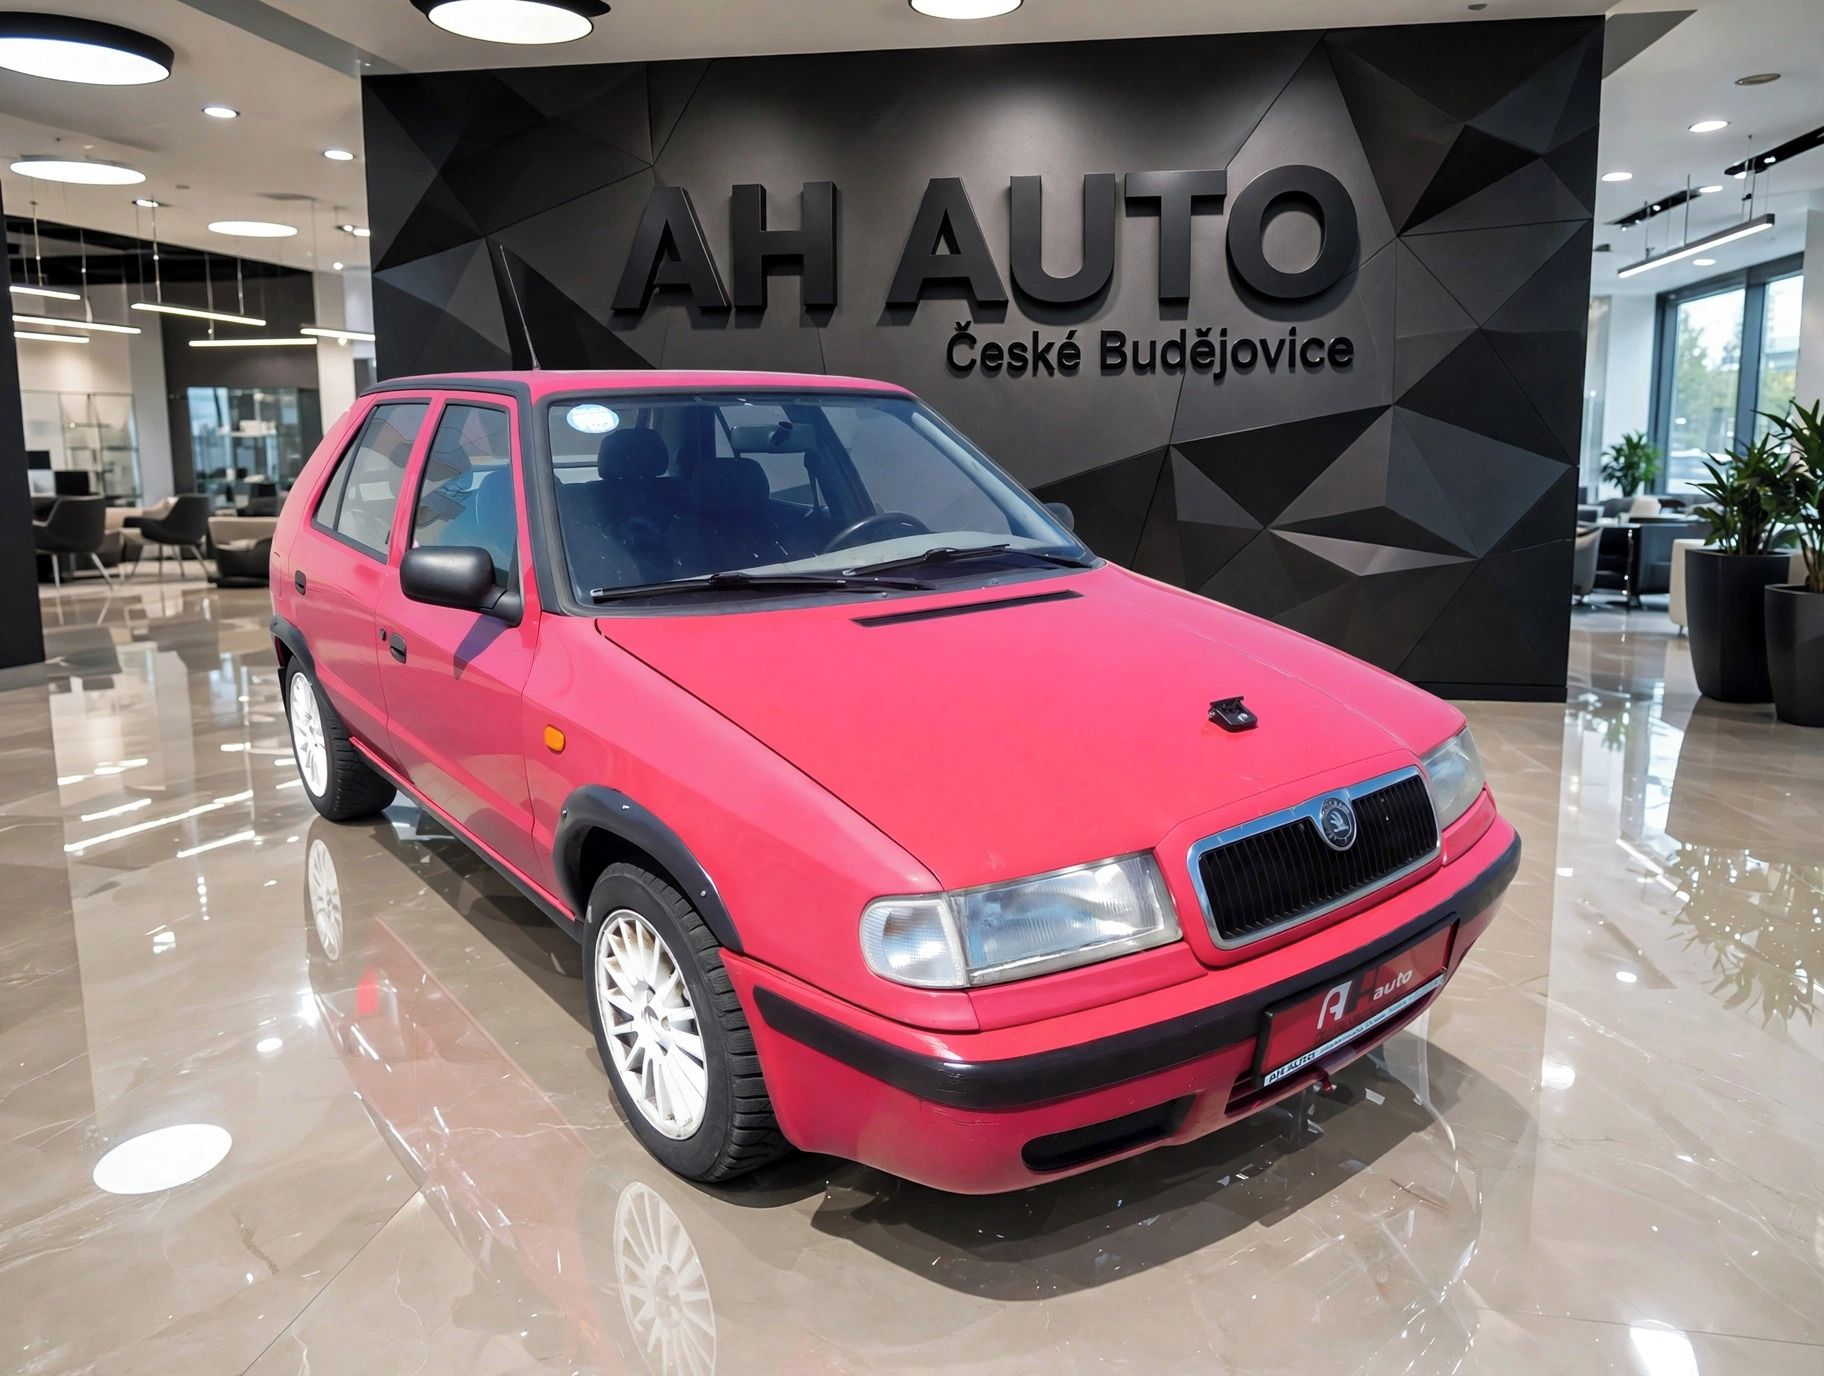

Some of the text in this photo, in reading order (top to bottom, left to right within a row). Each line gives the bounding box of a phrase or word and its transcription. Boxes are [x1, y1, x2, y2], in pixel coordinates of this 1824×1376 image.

[611, 164, 1359, 316] AH AUTO
[945, 320, 1355, 379] České Budějovice
[1373, 970, 1413, 1001] auto
